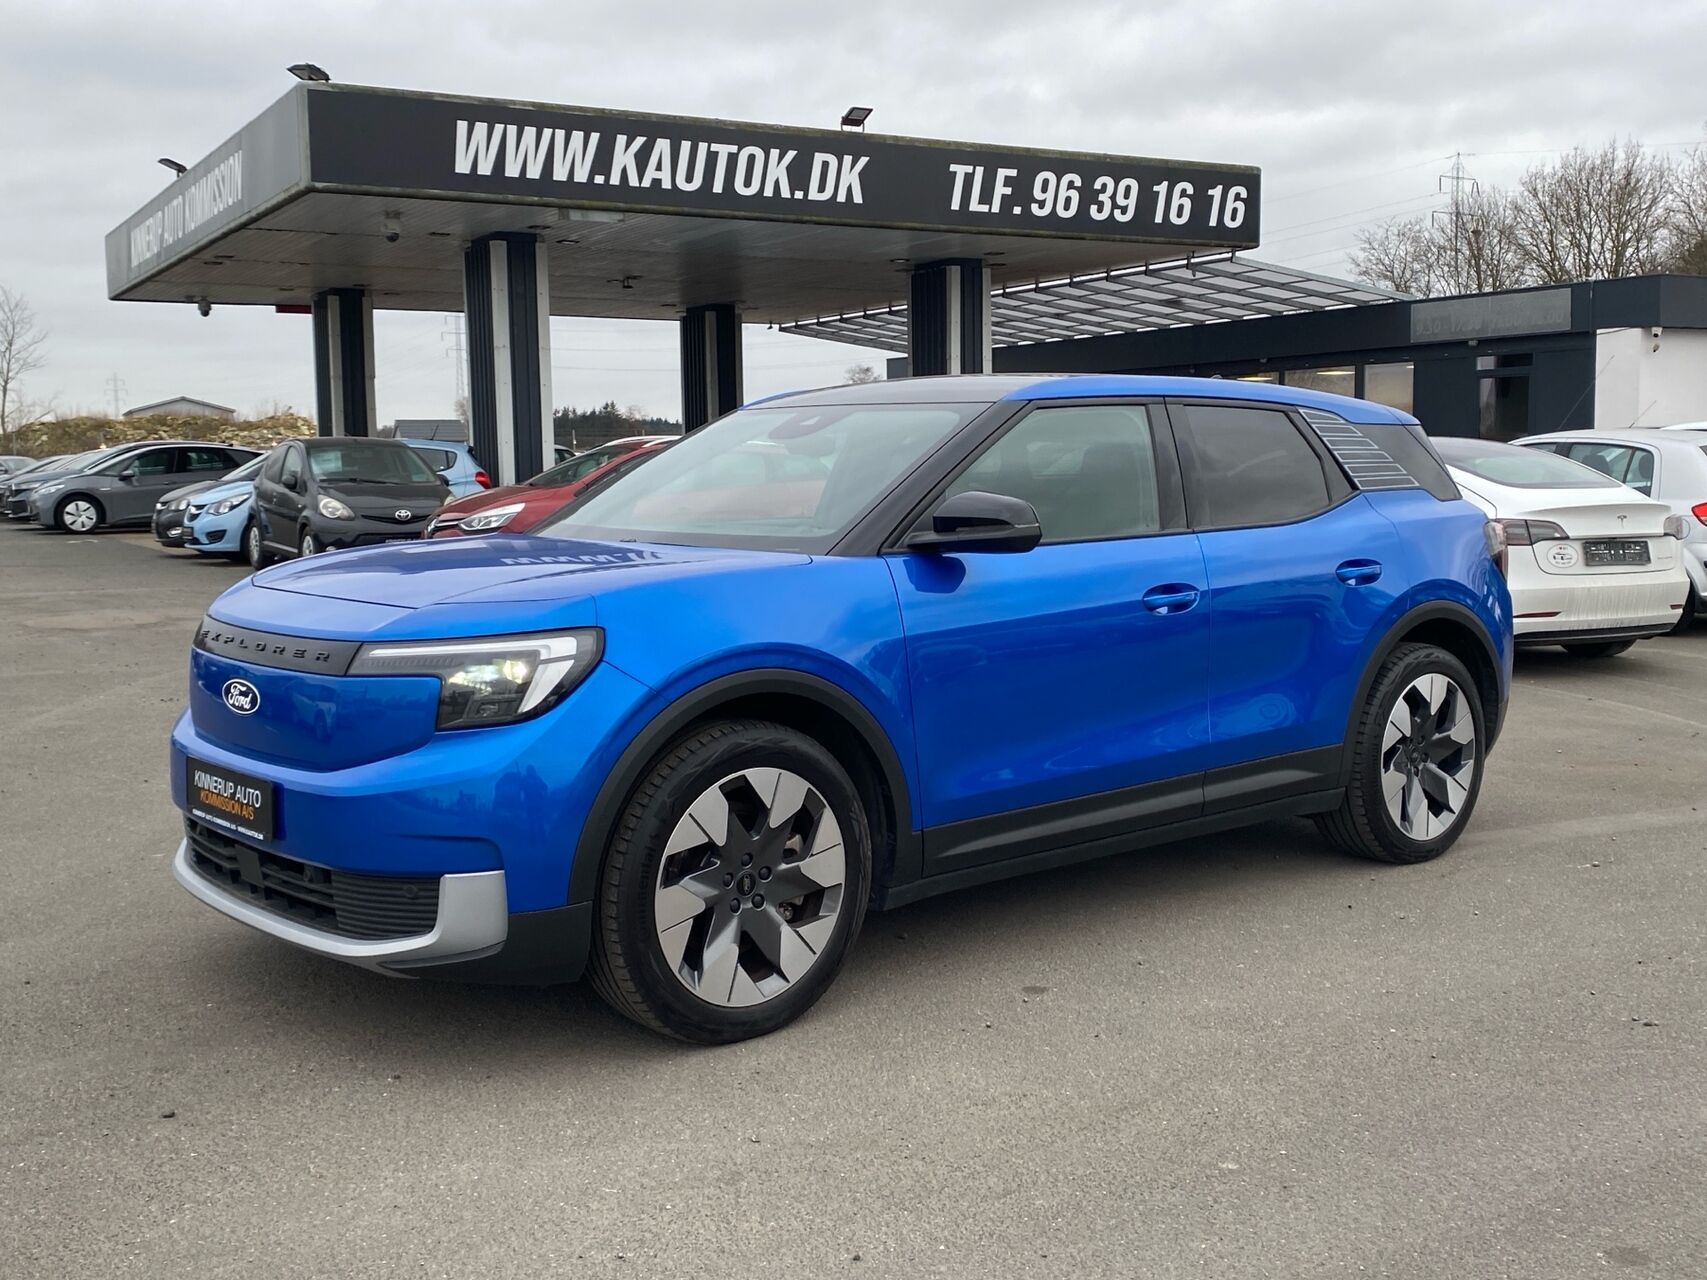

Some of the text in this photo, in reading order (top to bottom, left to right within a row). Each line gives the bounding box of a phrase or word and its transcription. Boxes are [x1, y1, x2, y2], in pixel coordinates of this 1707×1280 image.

[454, 120, 870, 204] WWW.KAUTOK.DK
[131, 149, 243, 268] KINNERUP AUTO KOMMISSION
[949, 163, 1248, 229] TLF. 96 39 16 16
[201, 629, 330, 662] EXPLORER
[228, 683, 252, 710] Ford
[194, 770, 261, 808] KINNERUP AUTO
[200, 789, 241, 815] KOMMISSION
